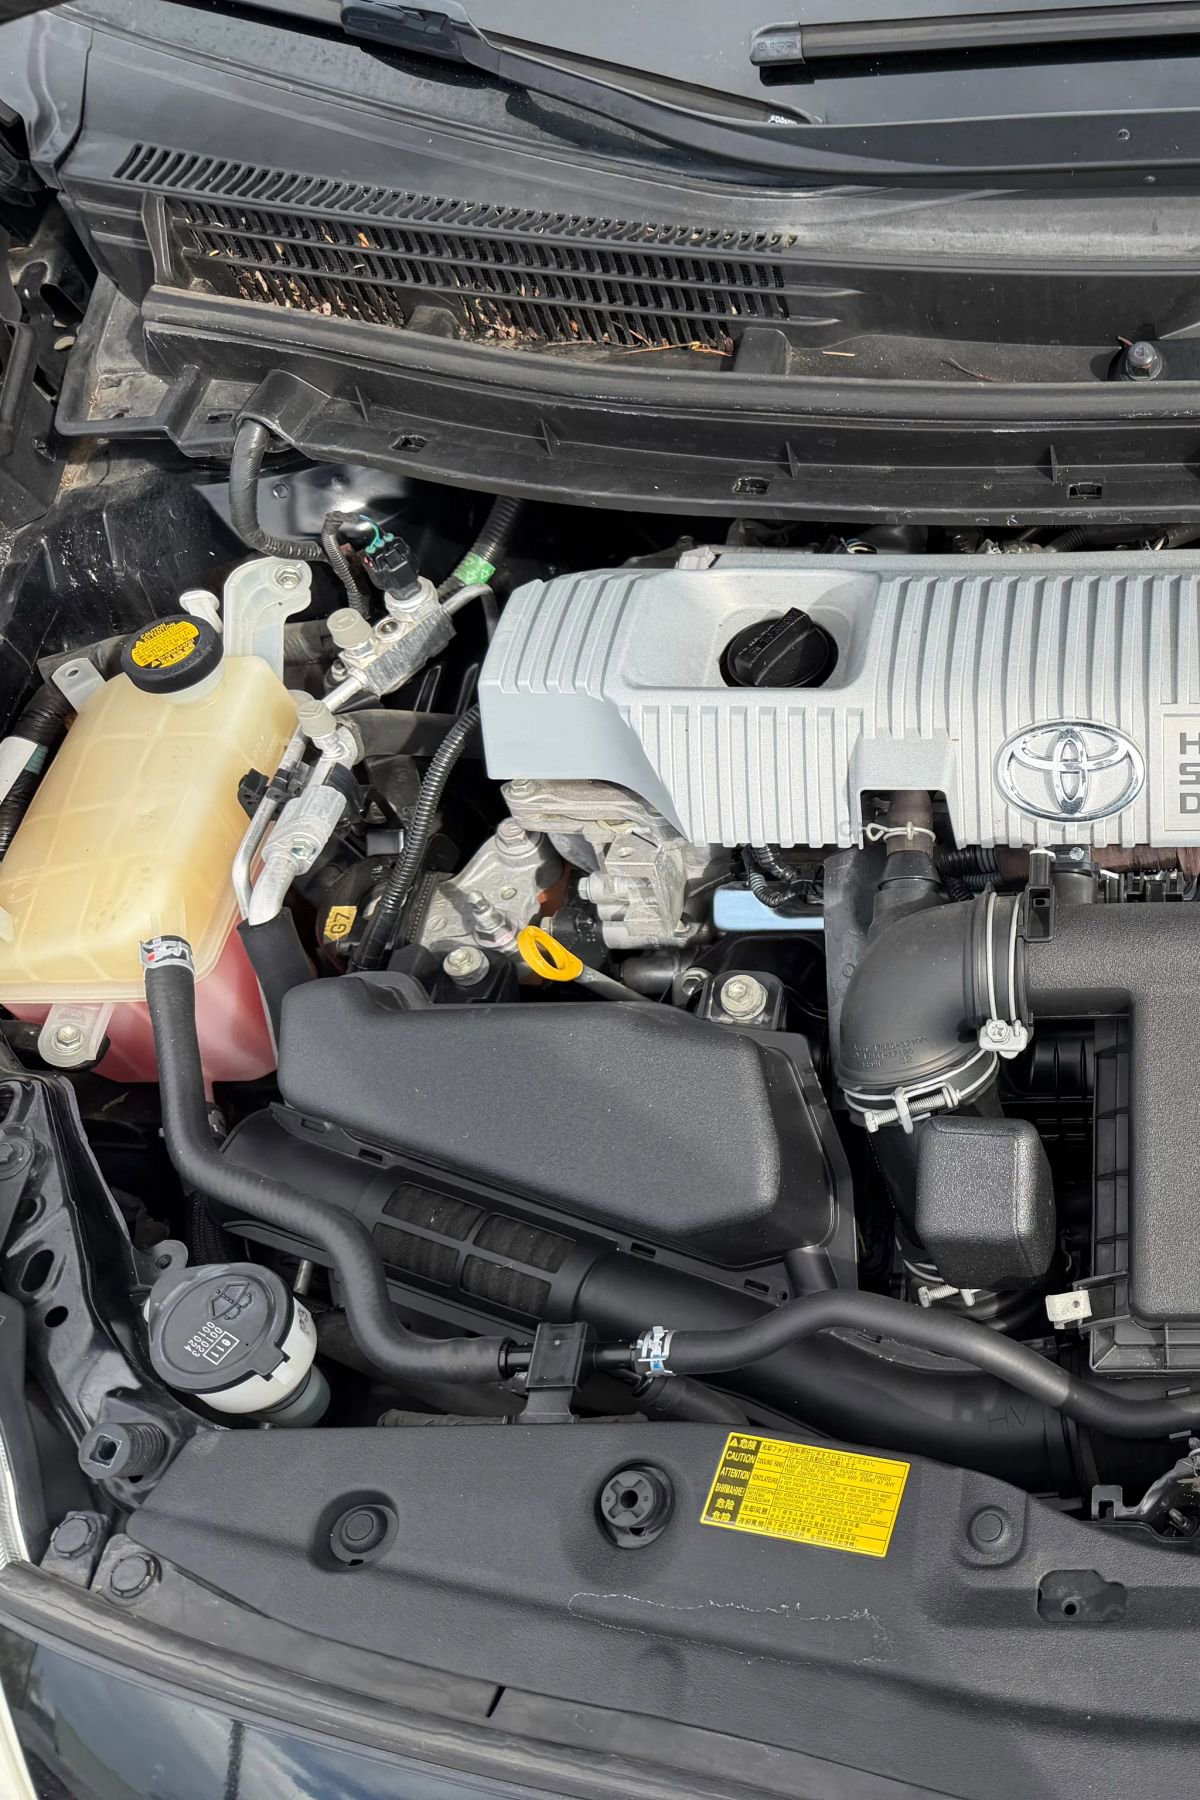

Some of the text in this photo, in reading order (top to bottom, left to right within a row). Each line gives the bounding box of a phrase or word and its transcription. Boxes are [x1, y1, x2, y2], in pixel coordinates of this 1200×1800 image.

[330, 912, 350, 934] G7
[183, 1321, 216, 1352] 001024
[191, 1327, 223, 1358] 001023
[986, 1400, 1030, 1432] HV
[725, 1450, 756, 1464] CAUTION
[719, 1466, 751, 1480] ATTENTION
